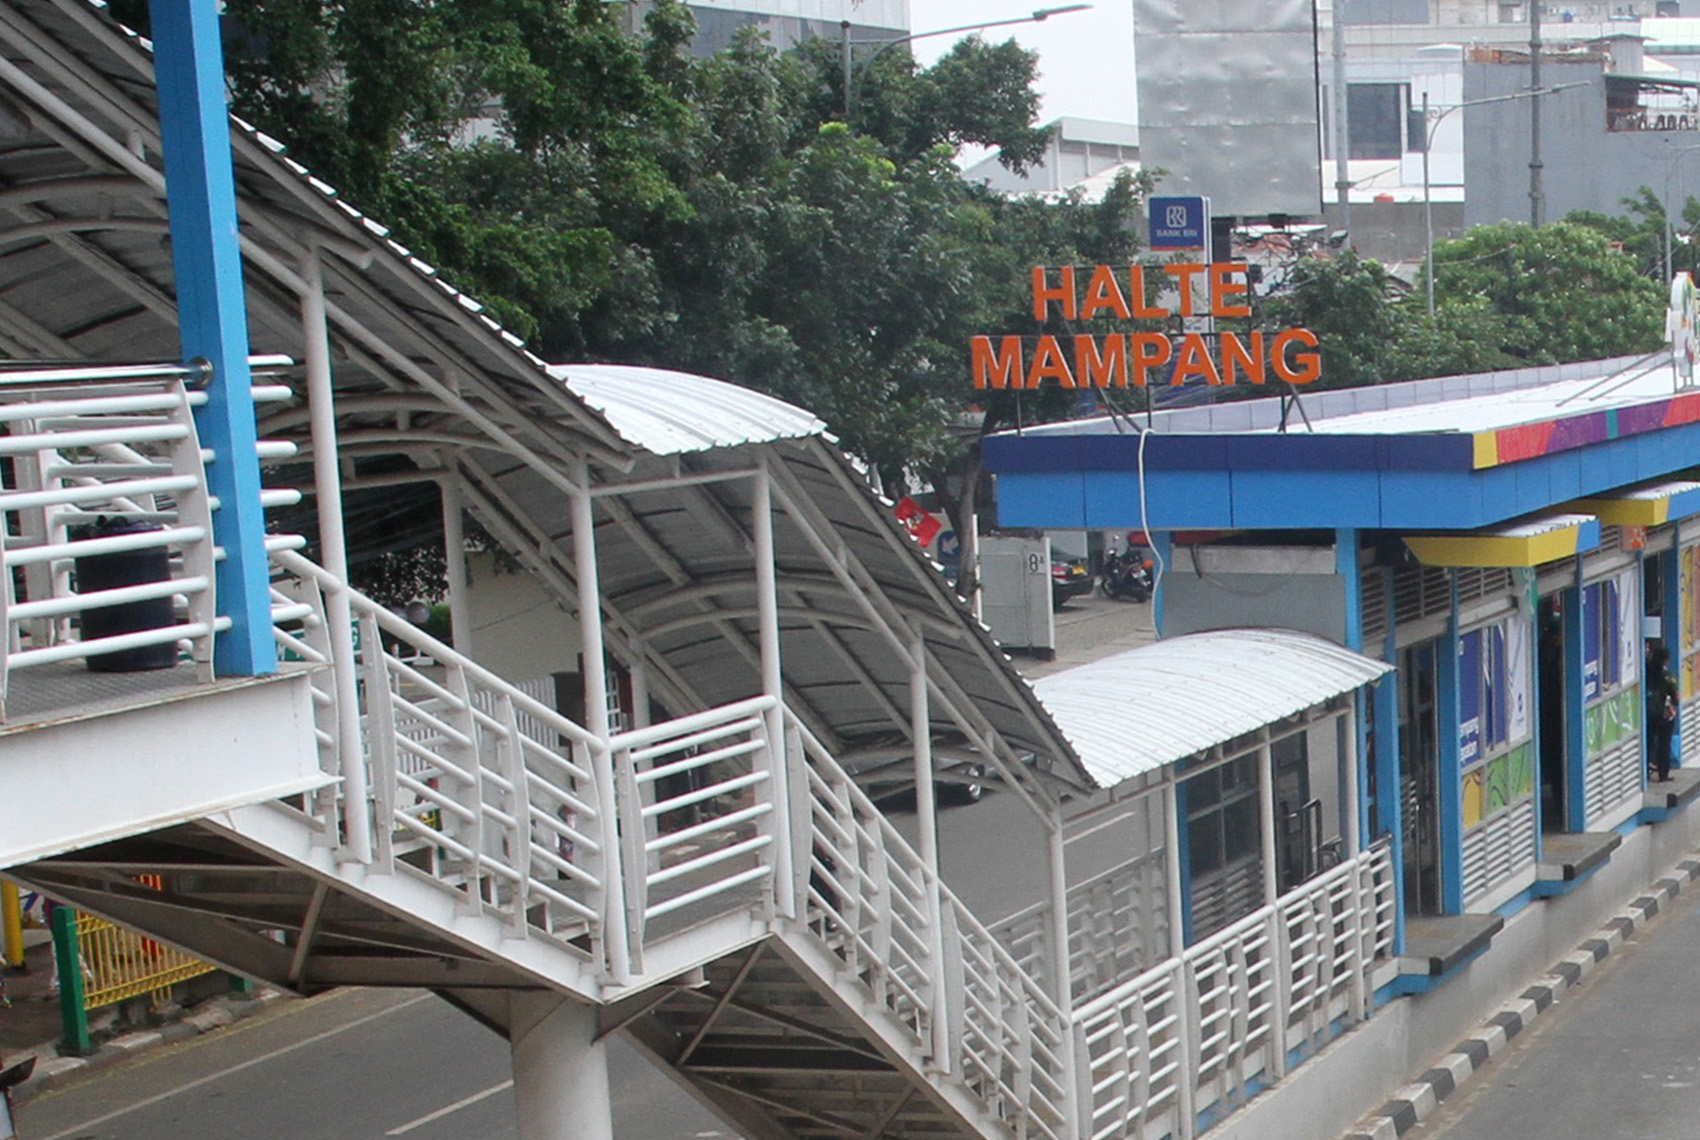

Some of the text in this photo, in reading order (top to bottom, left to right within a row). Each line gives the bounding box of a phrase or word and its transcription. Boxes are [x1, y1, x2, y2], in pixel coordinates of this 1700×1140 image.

[1156, 229, 1181, 237] BANK
[1031, 263, 1251, 321] HALTE
[970, 328, 1322, 389] MAMPANG
